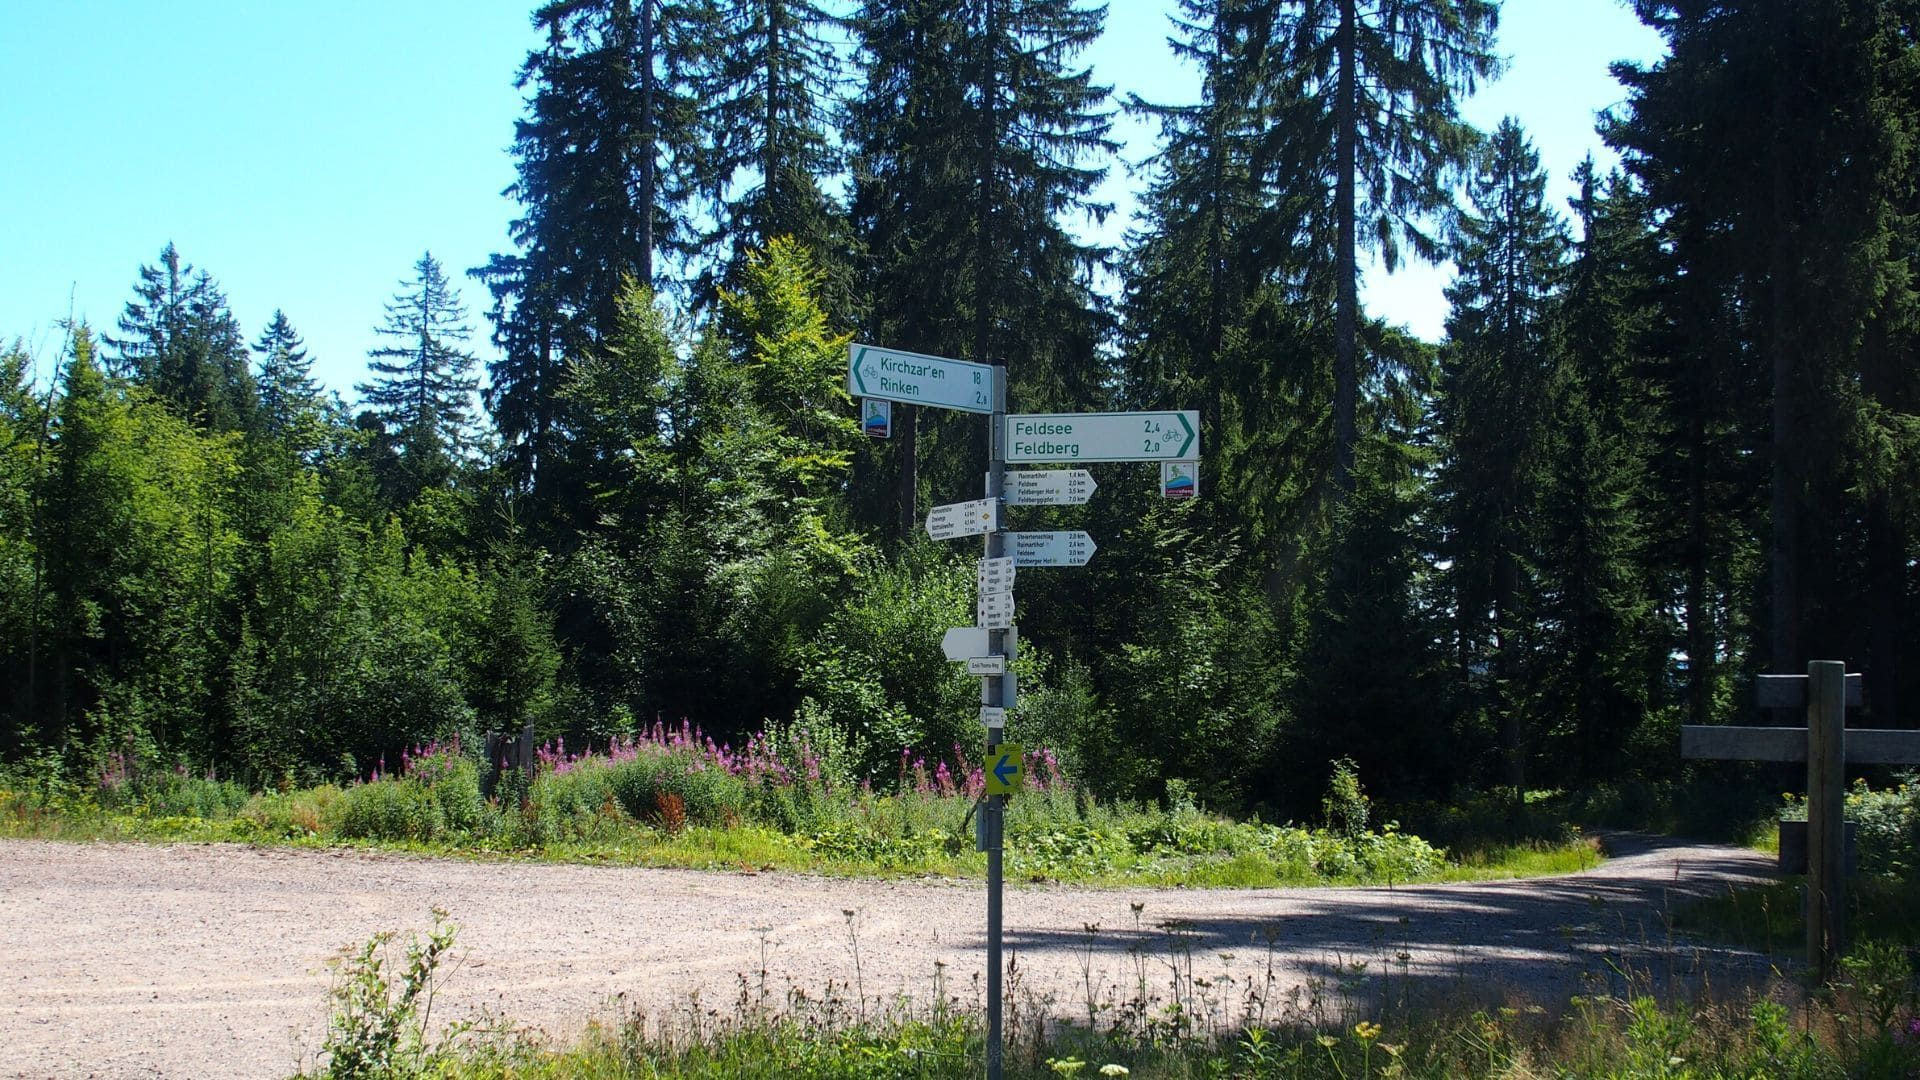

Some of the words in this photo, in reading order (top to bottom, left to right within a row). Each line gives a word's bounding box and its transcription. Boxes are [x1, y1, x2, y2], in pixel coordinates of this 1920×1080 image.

[973, 371, 981, 385] 18
[880, 377, 919, 396] Rinken
[1015, 422, 1073, 436] Feldsee
[1015, 442, 1080, 457] Feldberg
